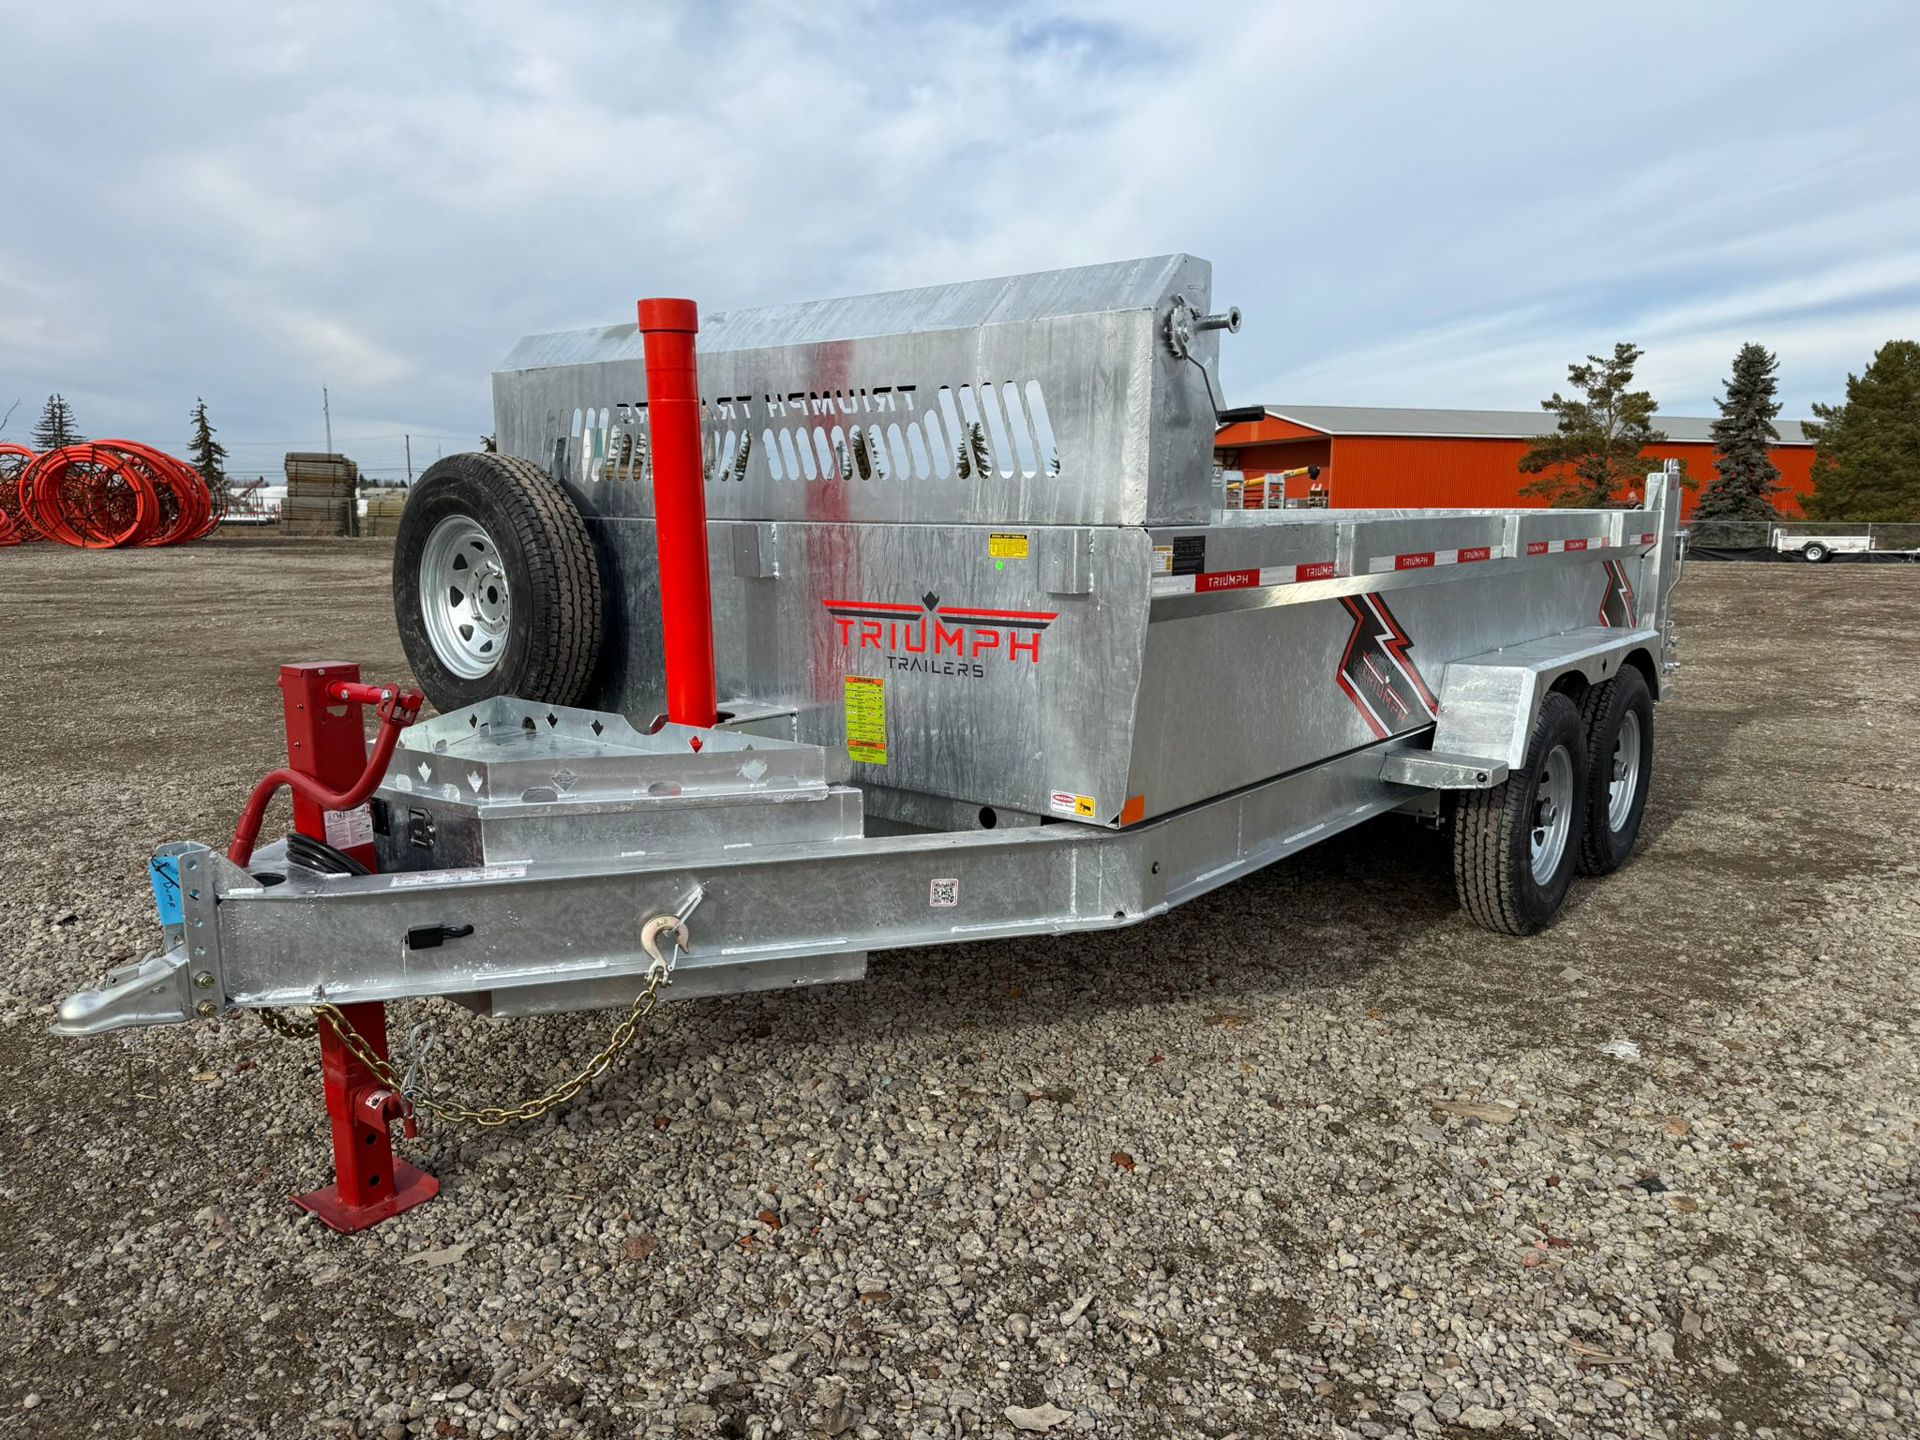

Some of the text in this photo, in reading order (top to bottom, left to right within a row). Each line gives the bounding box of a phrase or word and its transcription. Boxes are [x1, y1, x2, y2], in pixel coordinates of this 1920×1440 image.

[1402, 556, 1429, 566] TRIUMPH
[1463, 550, 1486, 560] TRIUMPH
[1305, 564, 1334, 577] TRIUMP
[1208, 574, 1249, 588] TRIUMPH
[835, 617, 1042, 664] TRIUMPH
[886, 654, 984, 679] TRAILERS
